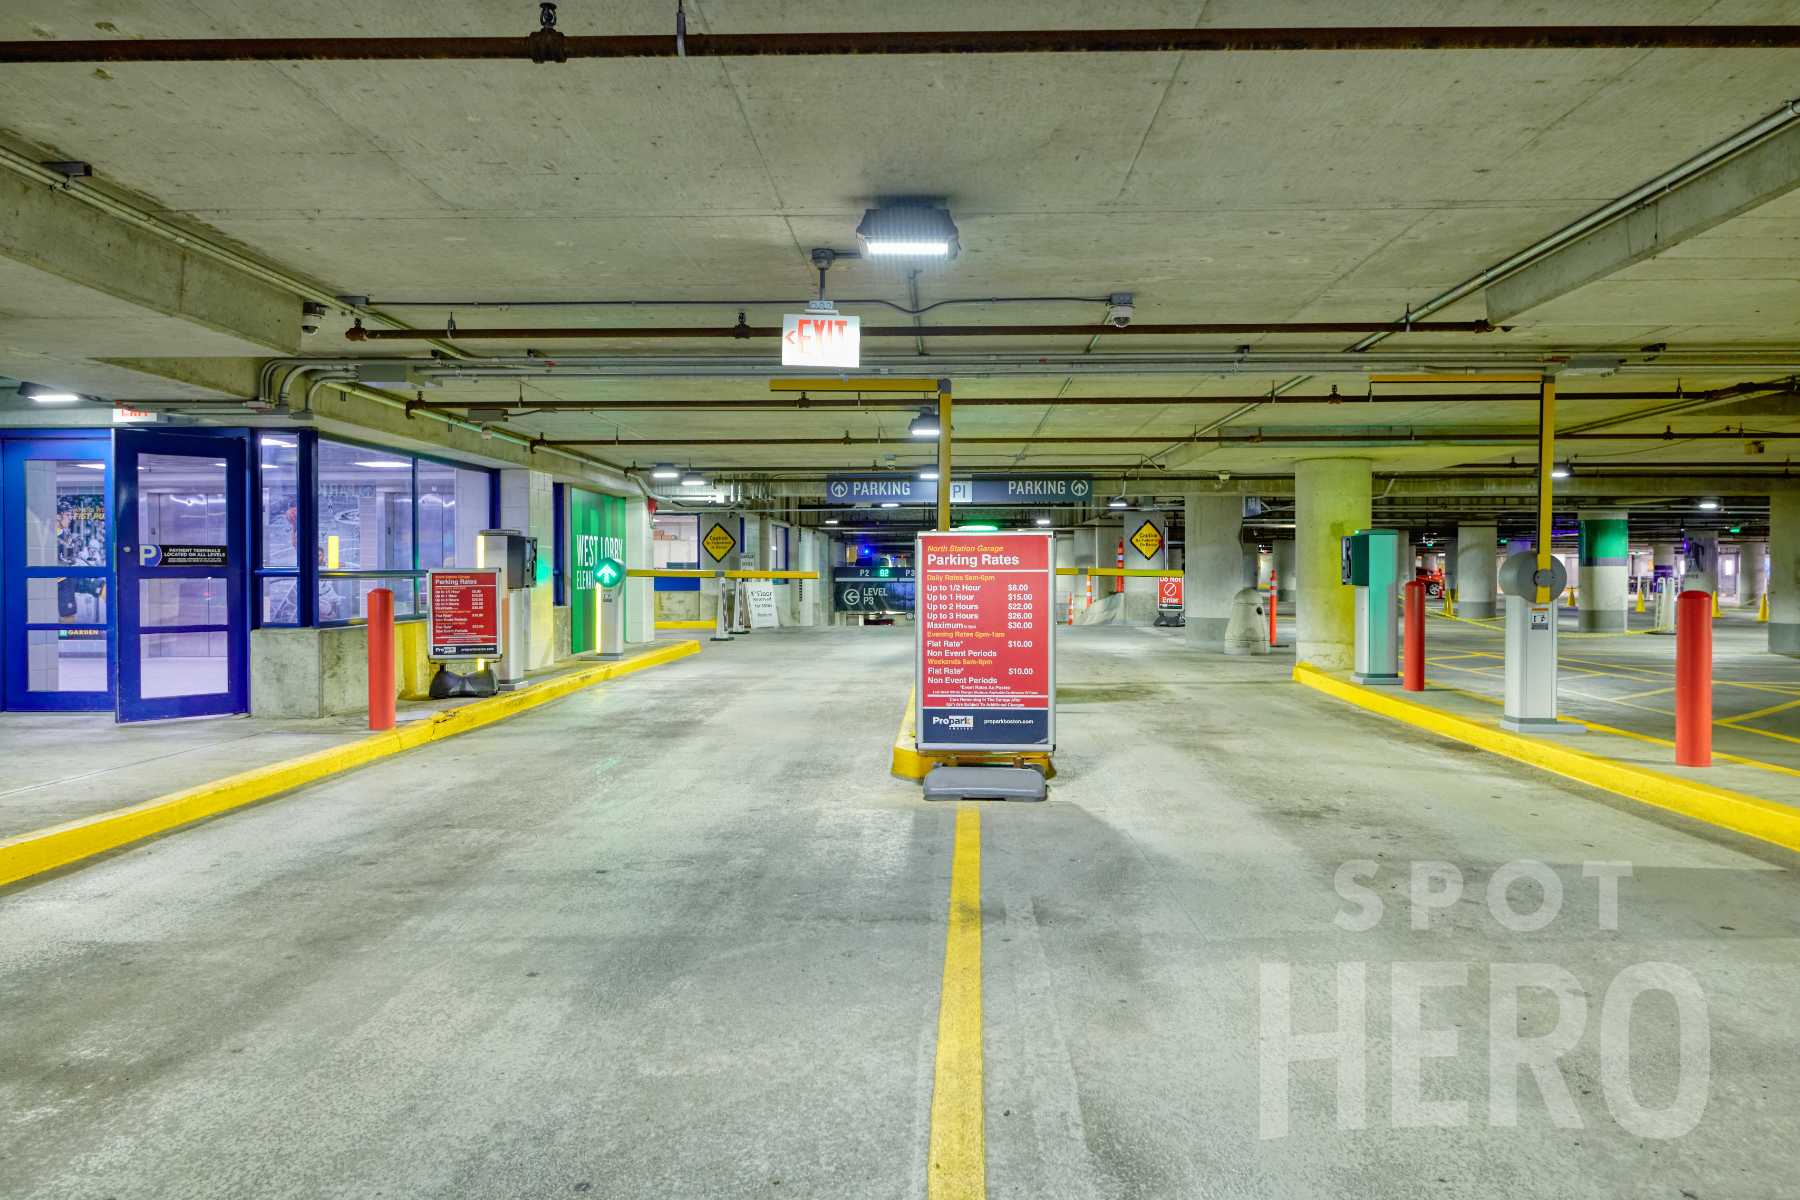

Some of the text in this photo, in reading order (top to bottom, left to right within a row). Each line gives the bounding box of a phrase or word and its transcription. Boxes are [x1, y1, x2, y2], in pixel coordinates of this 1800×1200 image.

[797, 318, 848, 352] EXIT
[853, 481, 911, 496] PARKING
[1008, 480, 1066, 495] PARKING
[577, 534, 598, 567] WEST
[977, 545, 1004, 553] Garage
[927, 553, 1020, 567] Parking Rates
[860, 569, 870, 577] P2
[863, 587, 888, 597] LEVEL
[927, 584, 938, 592] Up
[863, 596, 874, 605] P3
[927, 593, 938, 601] Up
[927, 603, 938, 611] Up
[927, 612, 938, 620] Up
[927, 621, 963, 629] Maximum
[1008, 640, 1033, 648] $10.00
[967, 649, 997, 657] Periods
[927, 667, 942, 675] Flat
[1008, 667, 1034, 675] $10.00
[927, 676, 998, 684] Non Event Periods
